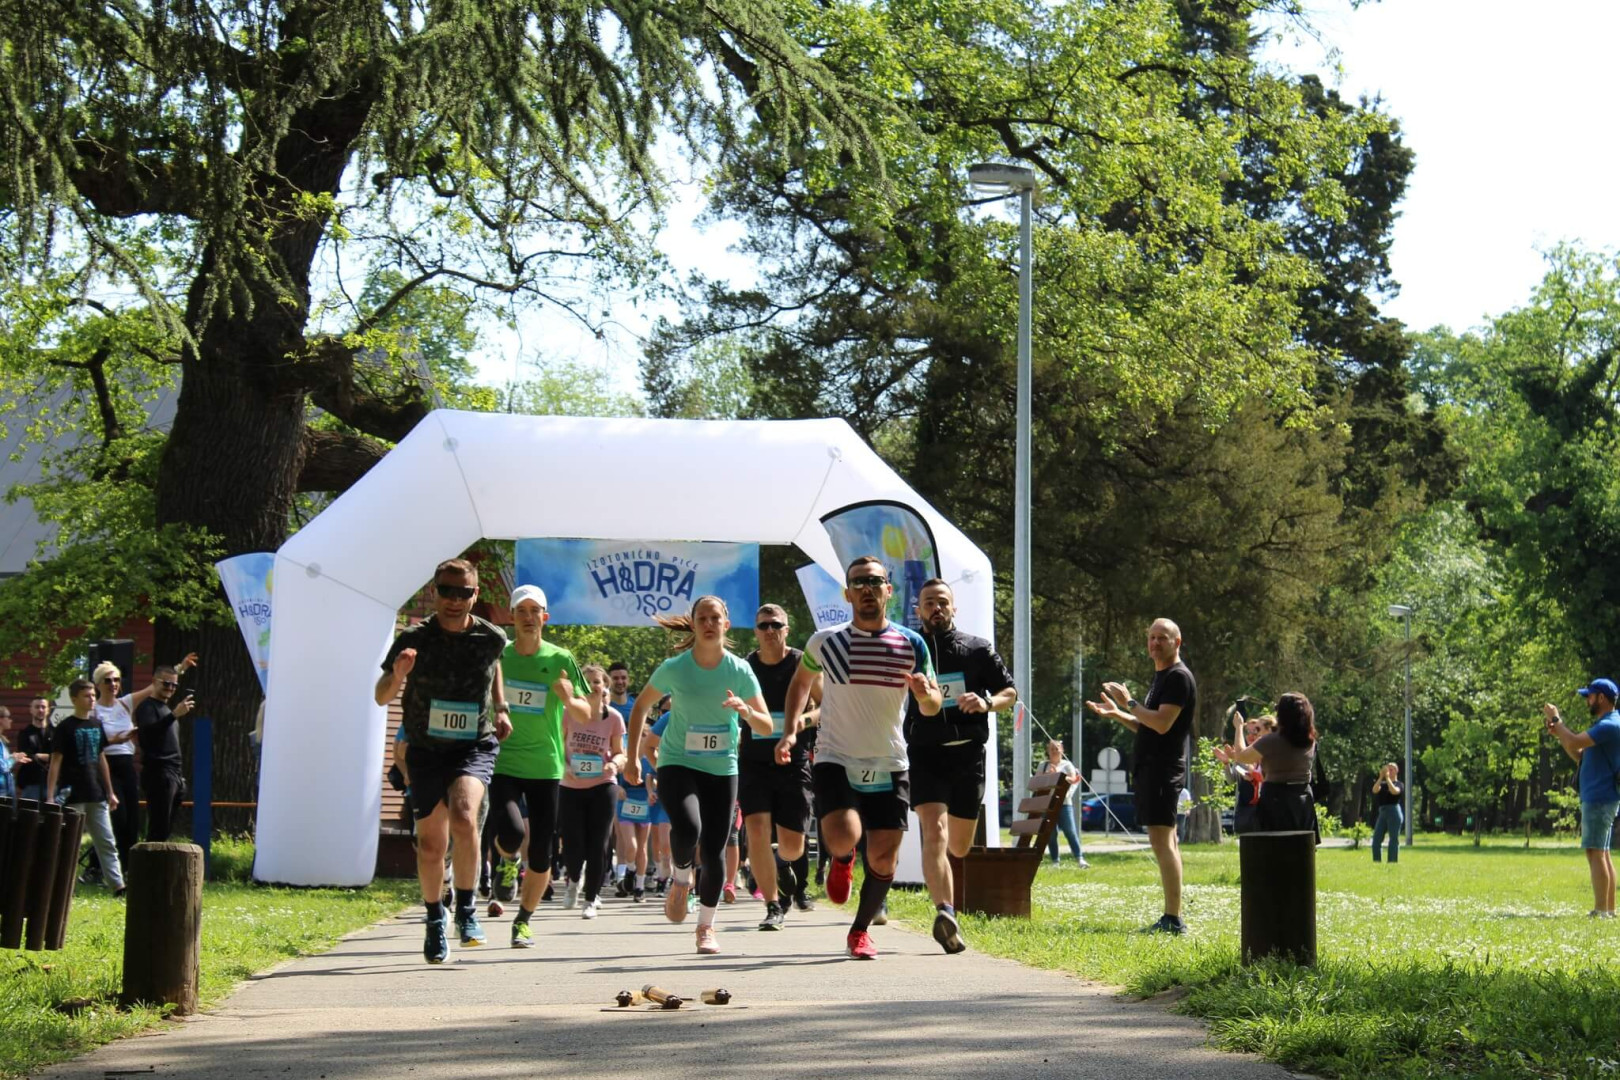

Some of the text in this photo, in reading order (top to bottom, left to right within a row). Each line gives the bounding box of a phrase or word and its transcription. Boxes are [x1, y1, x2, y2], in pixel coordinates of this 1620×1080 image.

[518, 691, 532, 705] 12
[443, 712, 467, 729] 100
[572, 732, 606, 746] PERFECT
[703, 734, 717, 749] 16
[580, 762, 592, 771] 23
[630, 805, 641, 814] 37
